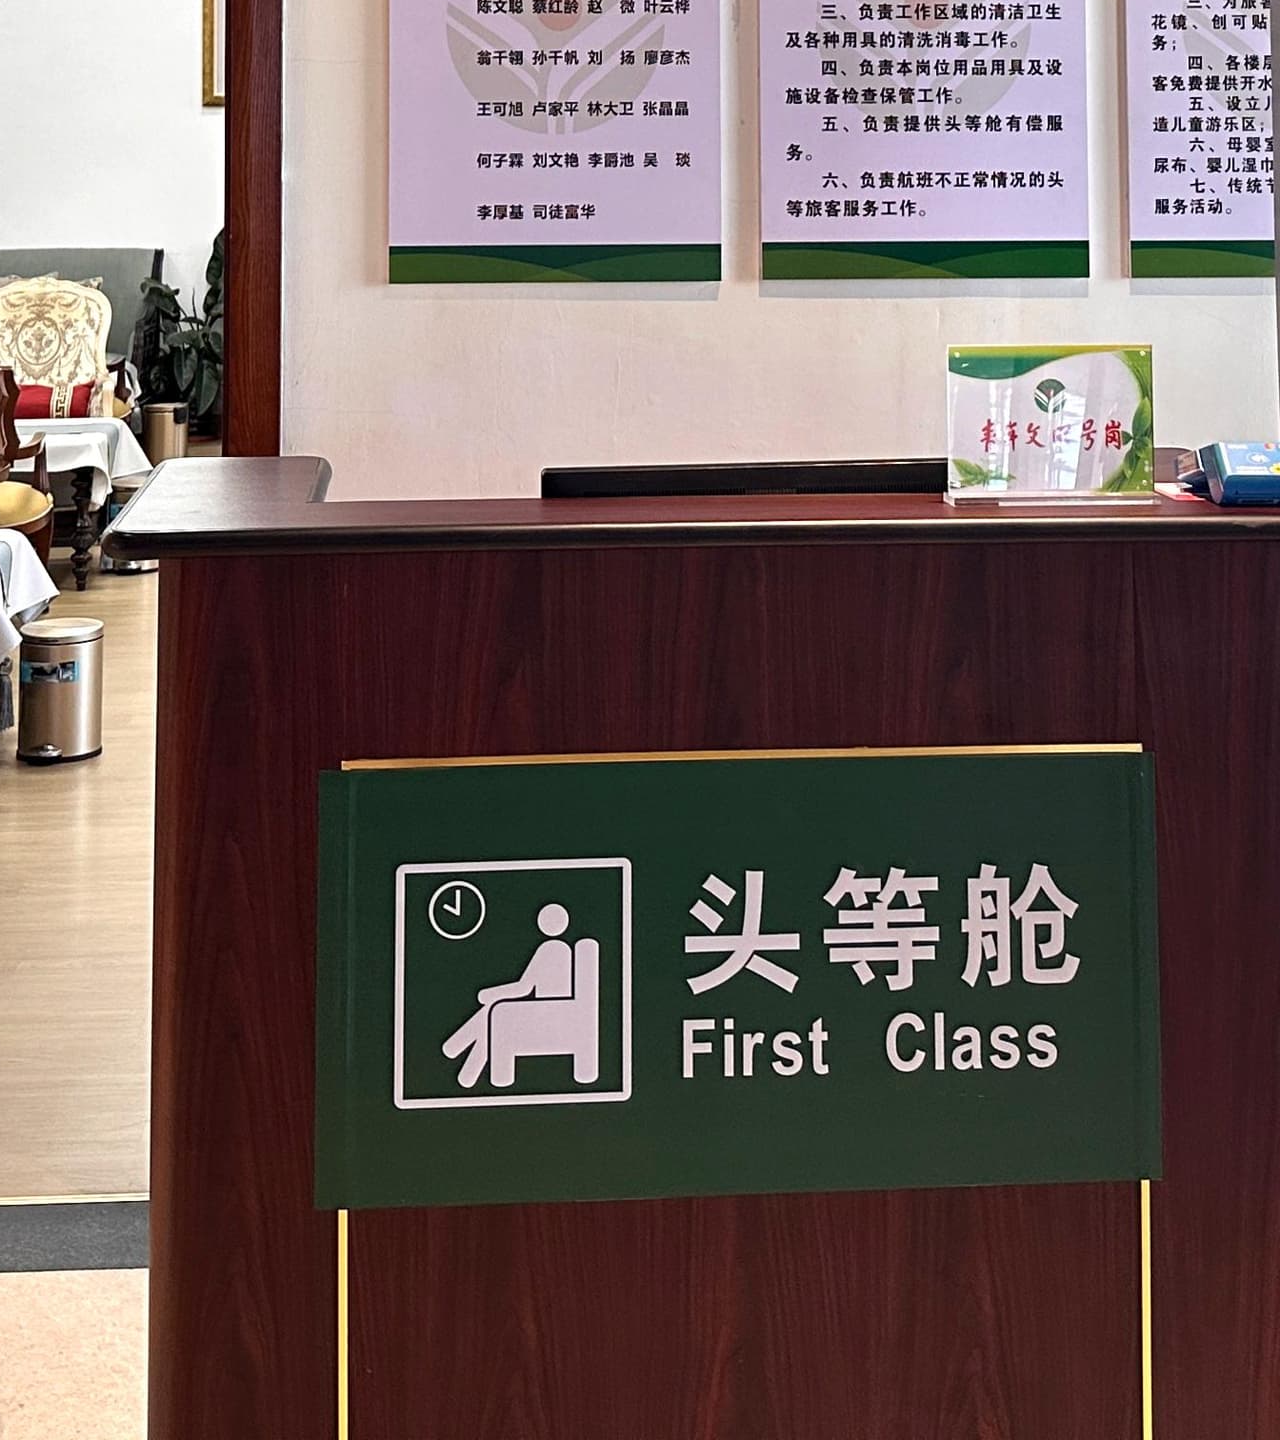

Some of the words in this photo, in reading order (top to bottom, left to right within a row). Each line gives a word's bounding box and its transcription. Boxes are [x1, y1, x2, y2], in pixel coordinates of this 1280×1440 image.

[477, 0, 524, 14] 陈文聪
[532, 0, 579, 14] 蔡红龄
[644, 0, 690, 14] 叶云桦
[821, 3, 1062, 20] 三、负责工作区域的清洁卫生
[1152, 14, 1267, 30] 花镜、创可贴
[785, 32, 1019, 48] 及各种用具的清洗消毒工作。
[532, 51, 579, 65] 孙千帆
[644, 51, 690, 65] 廖彦杰
[821, 59, 1063, 76] 四、负责本岗位用品用具及设
[1152, 76, 1272, 91] 客免费提供开水
[785, 87, 964, 104] 施设备检查保管工作。
[477, 102, 524, 117] 王可旭
[533, 102, 579, 117] 卢家平
[587, 102, 634, 116] 林大卫
[822, 115, 1063, 132] 五、负责提供头等舱有偿服
[477, 153, 524, 168] 何子霖
[533, 153, 579, 168] 刘文艳
[588, 153, 634, 168] 李爵池
[786, 144, 813, 161] 务。
[822, 171, 1064, 189] 六、负责航班不正常情况的头
[477, 205, 524, 220] 李厚基
[533, 204, 595, 220] 司徒富华
[787, 200, 928, 217] 等旅客服务工作。
[1155, 199, 1232, 215] 服务活动。
[683, 862, 1082, 996] 头等舱
[682, 1017, 829, 1078] First
[886, 1013, 1059, 1073] Class
